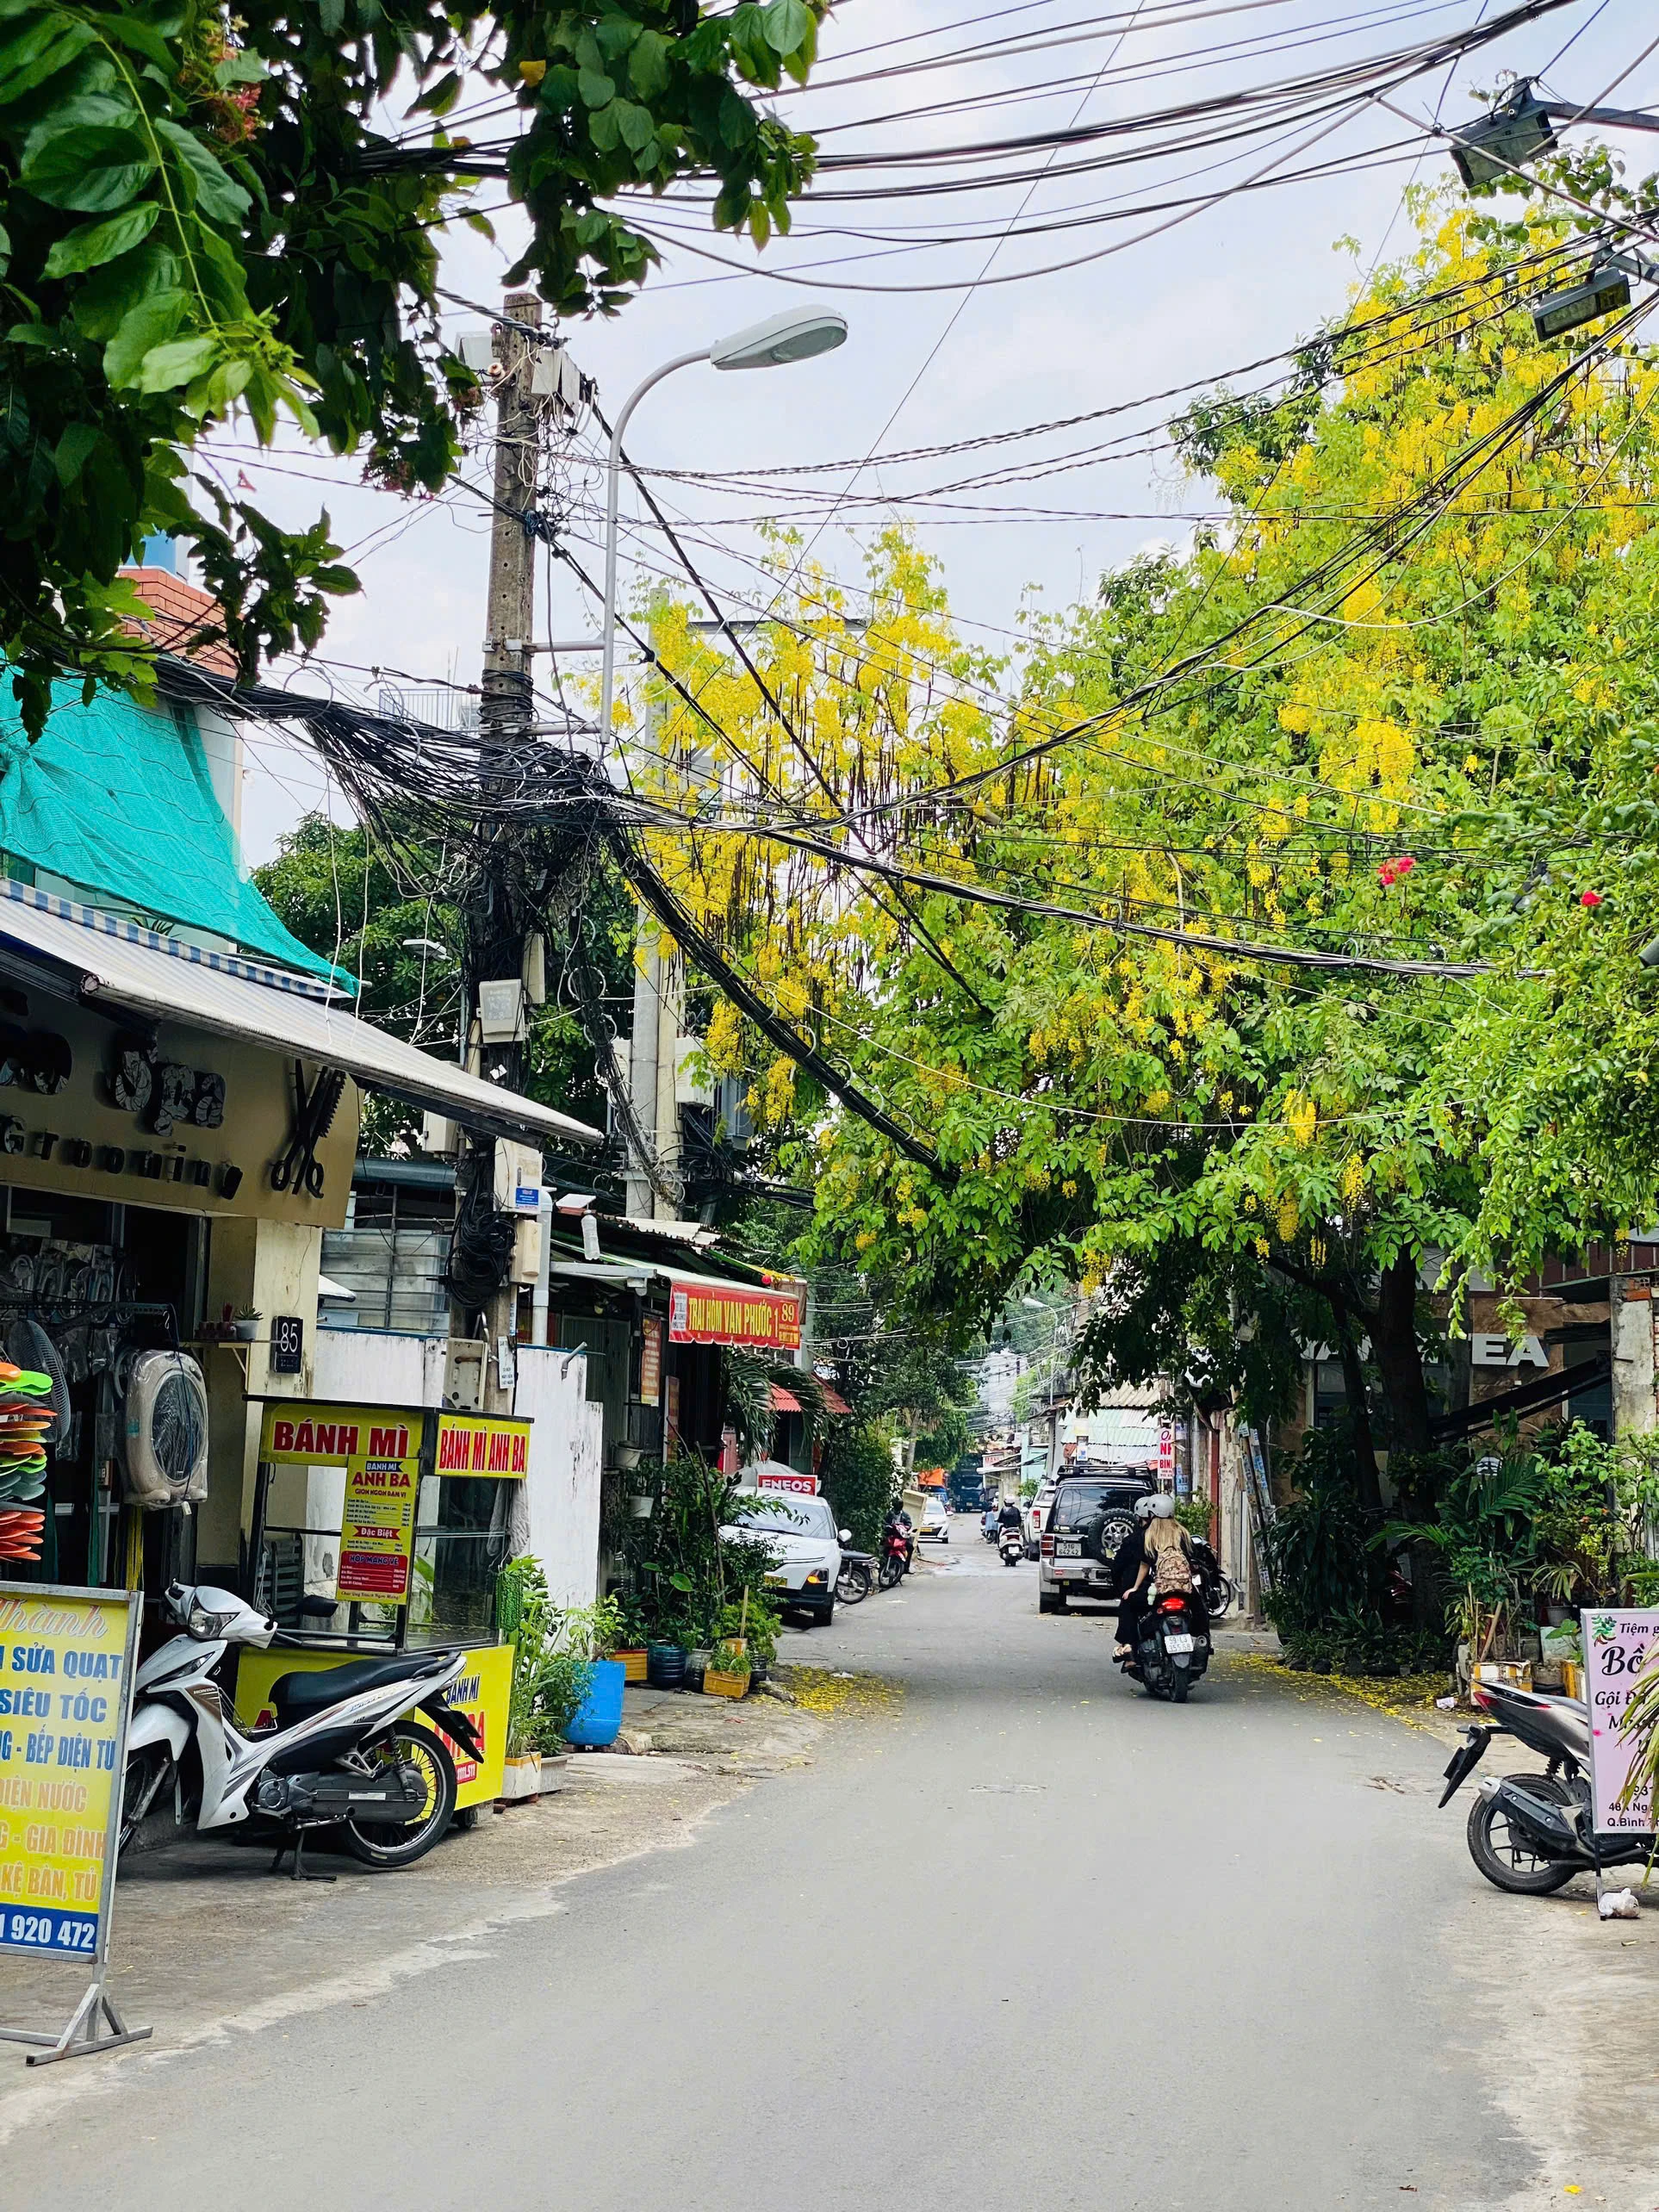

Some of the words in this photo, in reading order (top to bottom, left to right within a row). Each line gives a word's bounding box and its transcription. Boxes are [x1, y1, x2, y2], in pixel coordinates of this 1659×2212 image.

[781, 1302, 795, 1322] 89
[280, 1322, 298, 1353] 85
[273, 1418, 359, 1457] BÁNH
[369, 1424, 409, 1458] MÌ
[438, 1423, 471, 1470] BÁNH
[471, 1426, 488, 1471] MÌ
[488, 1432, 511, 1472] ANH
[512, 1434, 526, 1473] BA
[351, 1471, 386, 1487] ANH
[389, 1473, 411, 1488] BA
[761, 1479, 811, 1493] ENEOS
[1619, 1622, 1649, 1636] Tiệm
[12, 1642, 56, 1675] SỬA
[63, 1650, 123, 1683] QUẠT
[0, 1687, 52, 1718] SIÊU
[59, 1687, 108, 1723] TỐC
[1595, 1691, 1620, 1709] Gội
[25, 1724, 54, 1764] BẾP
[37, 1779, 88, 1813] NƯỚC
[1607, 1817, 1645, 1827] Q.Bình
[26, 1823, 58, 1855] GIA
[73, 1867, 98, 1902] TỦ
[10, 1914, 52, 1943] 920
[57, 1920, 96, 1948] 472
